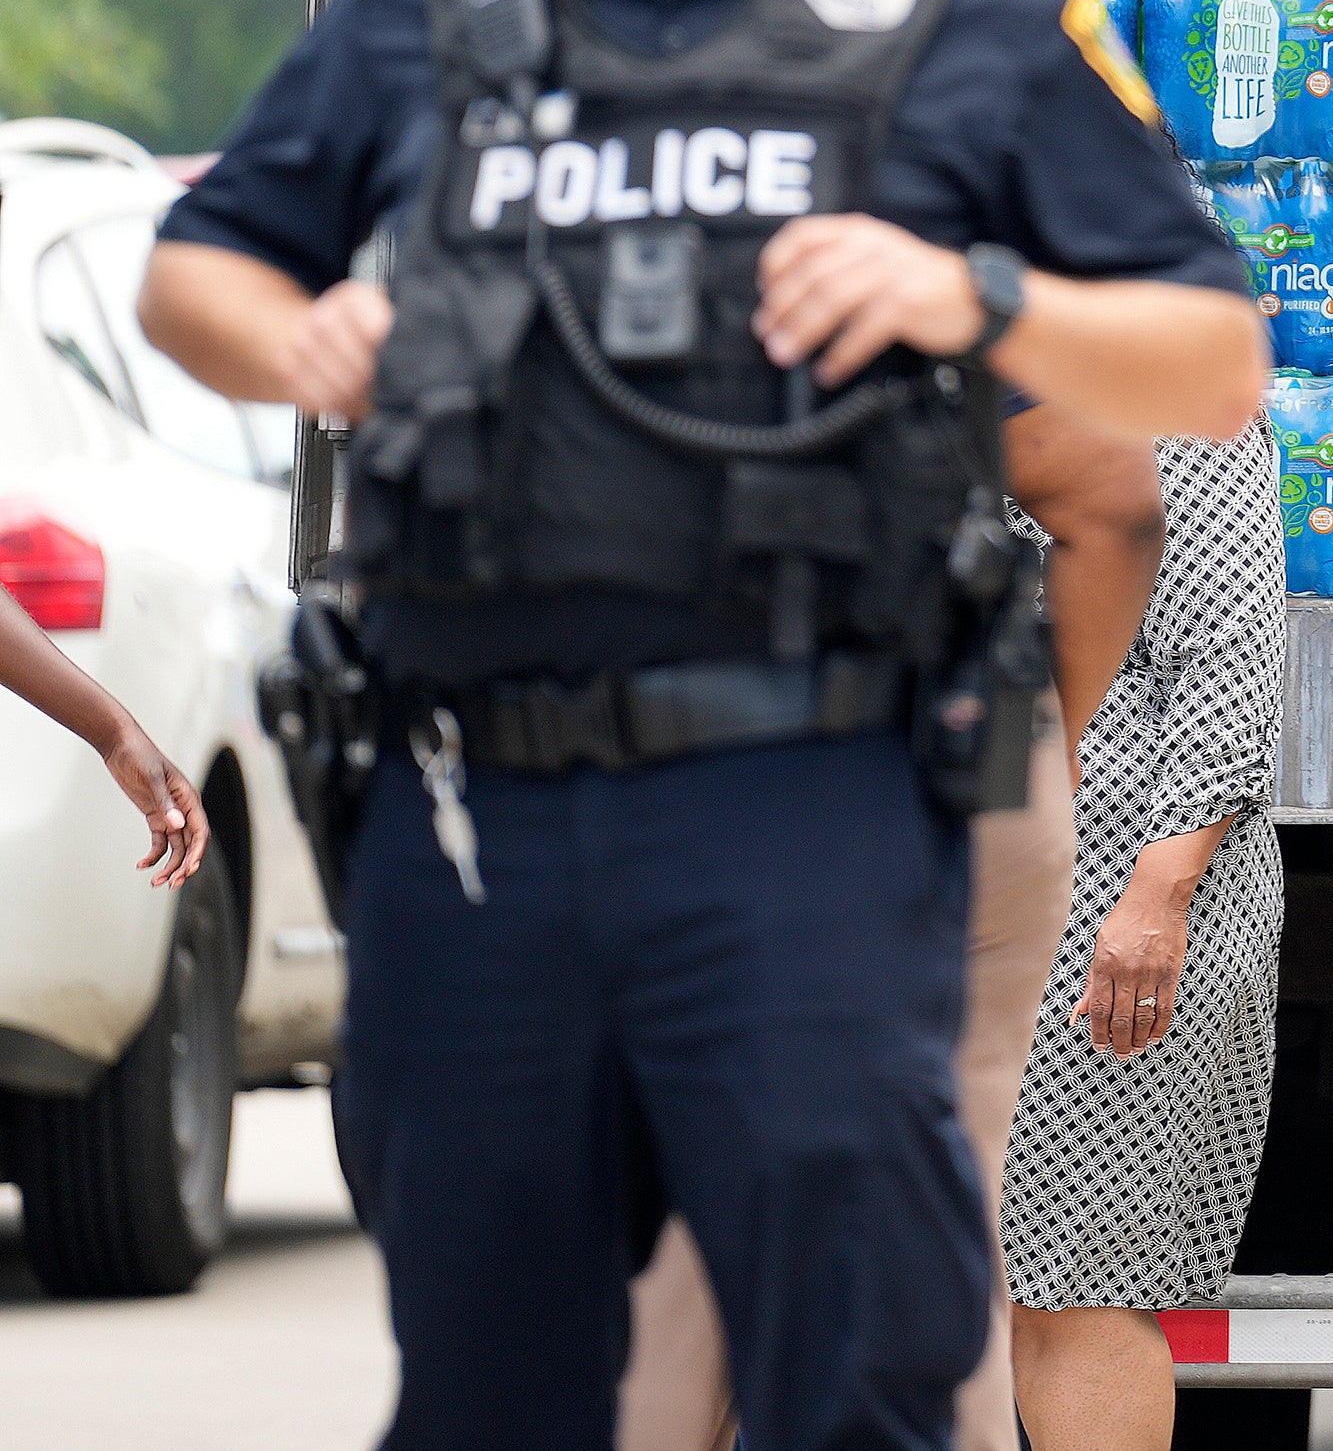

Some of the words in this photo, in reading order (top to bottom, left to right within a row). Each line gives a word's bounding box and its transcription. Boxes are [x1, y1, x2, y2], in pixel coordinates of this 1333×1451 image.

[1223, 0, 1248, 20] GIVE
[1250, 3, 1271, 25] THIS
[1222, 24, 1270, 54] BOTTLE
[1222, 54, 1268, 75] ANOTHER
[1222, 78, 1265, 120] LIFE
[470, 127, 817, 231] POLICE
[1283, 299, 1320, 311] PURIFIED
